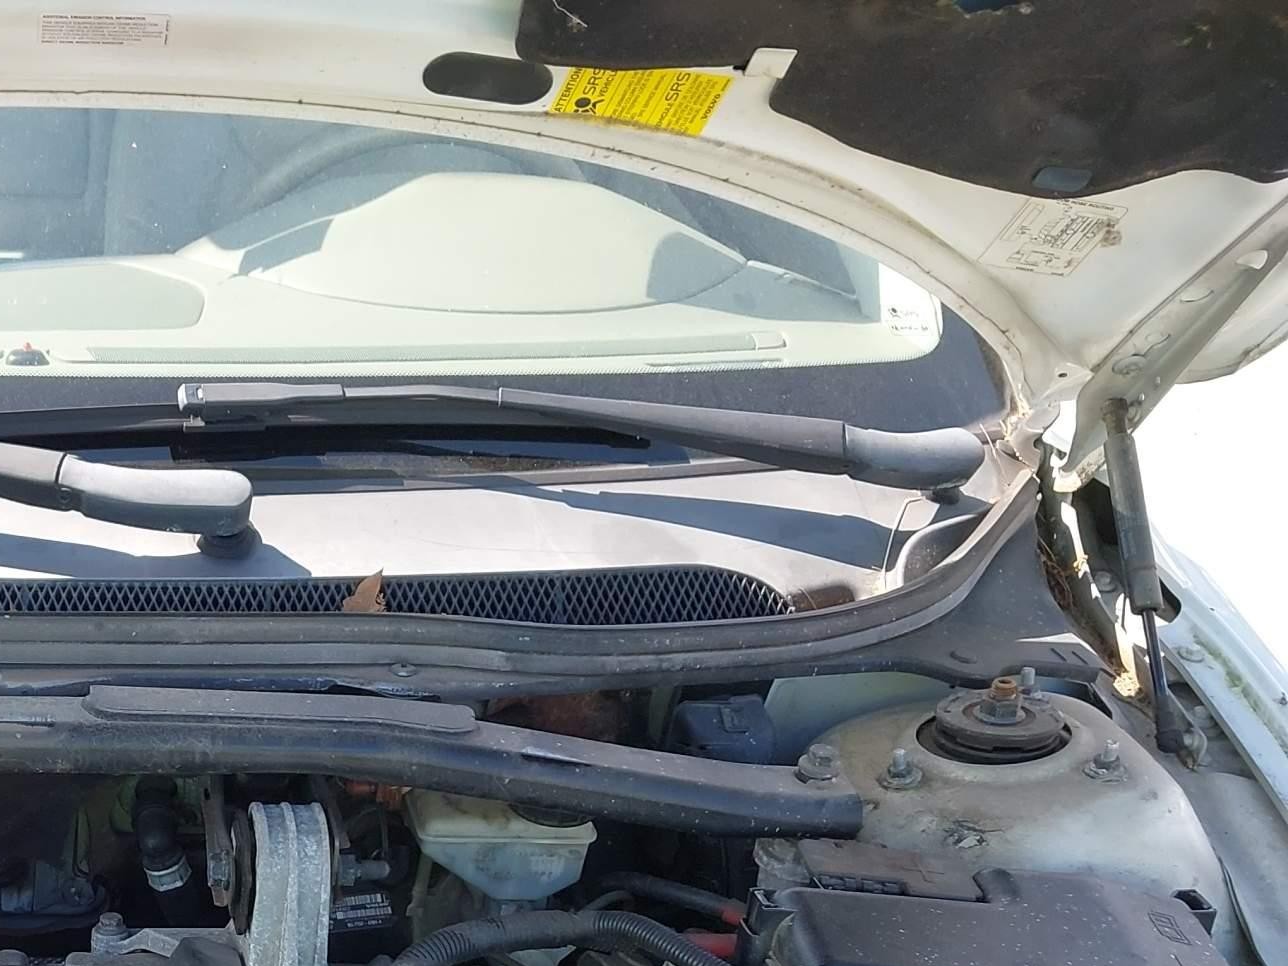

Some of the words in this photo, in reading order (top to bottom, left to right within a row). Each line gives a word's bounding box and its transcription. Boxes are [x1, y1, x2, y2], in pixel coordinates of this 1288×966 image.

[554, 68, 583, 112] ATTENTION
[598, 69, 618, 97] VEHICL
[665, 72, 691, 102] SRS
[700, 93, 721, 120] VOLVO
